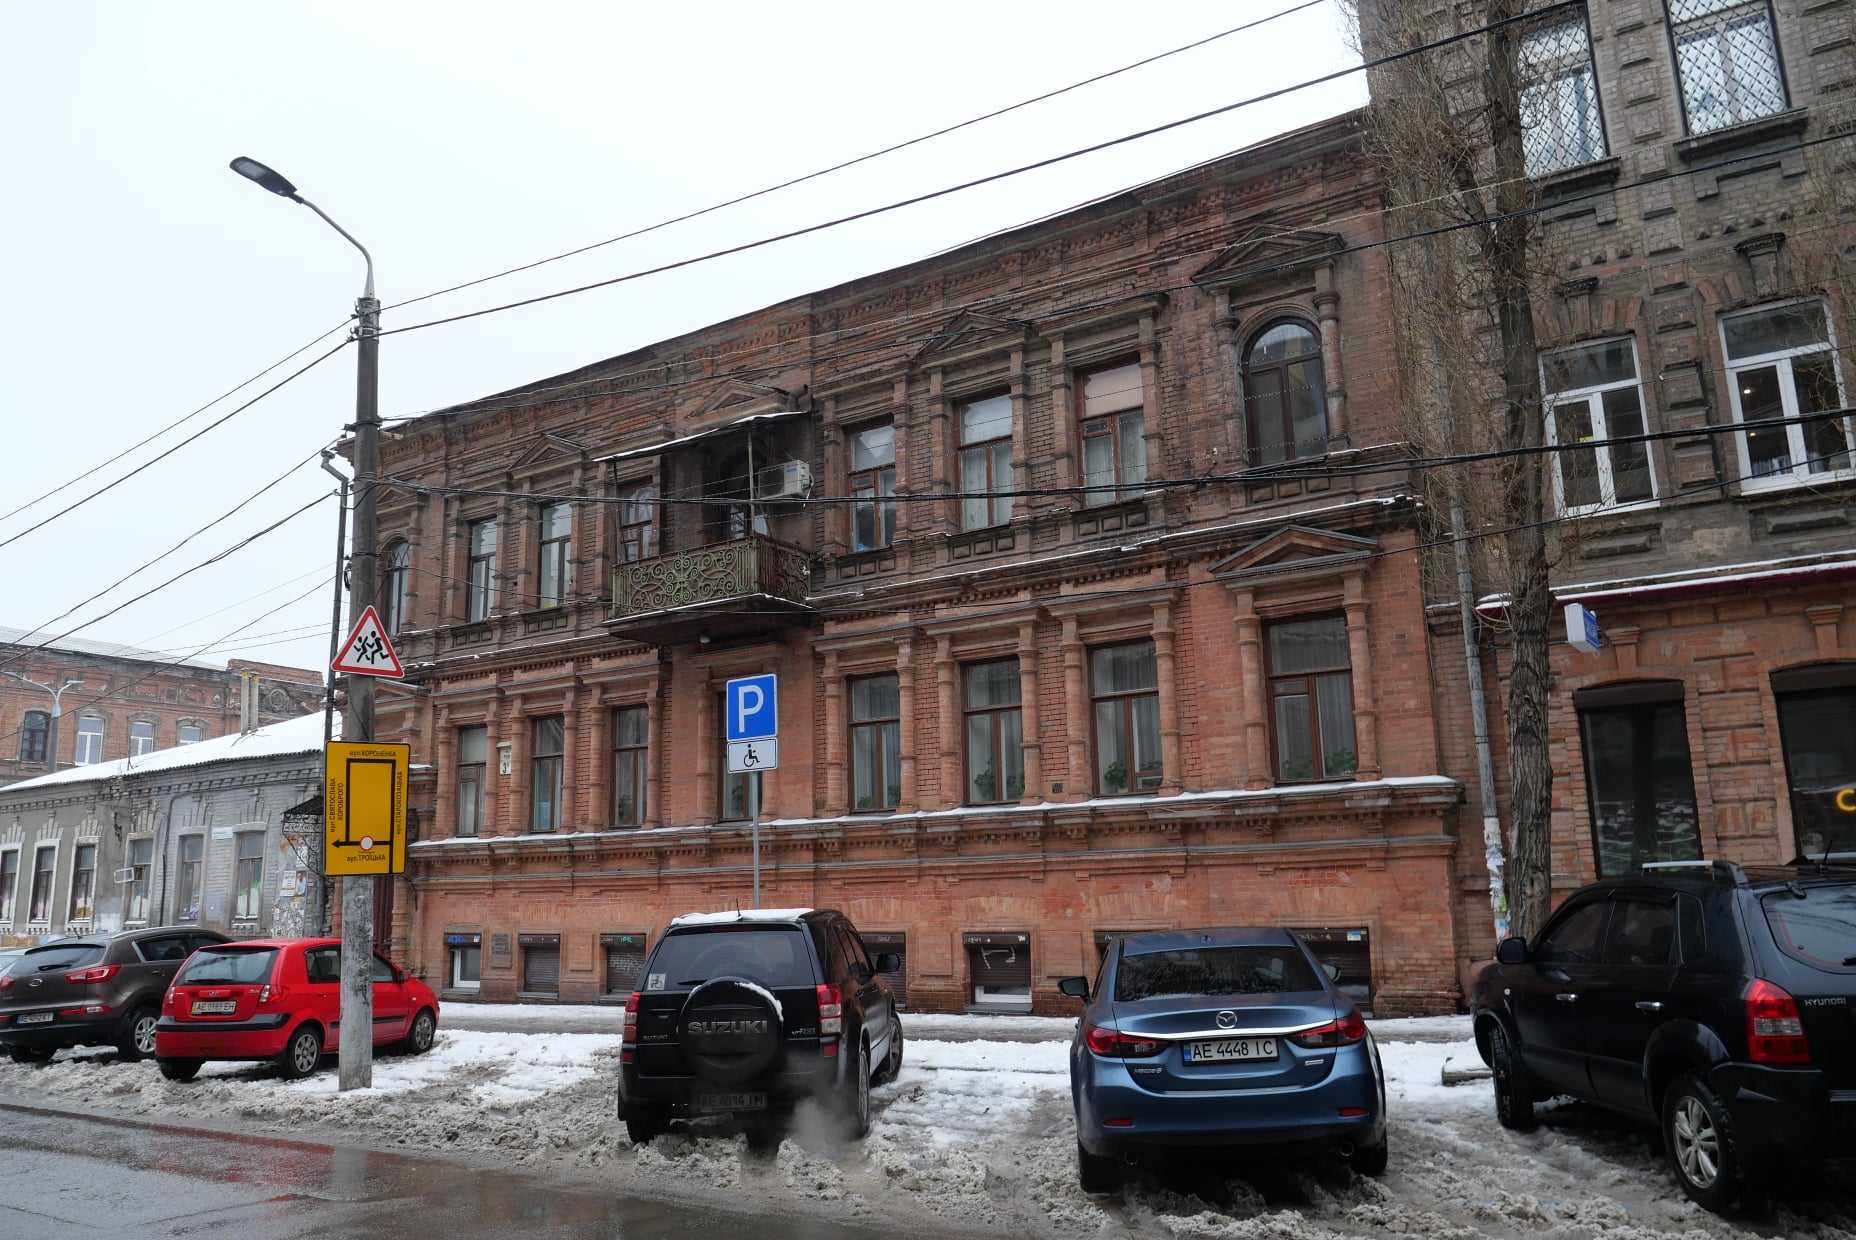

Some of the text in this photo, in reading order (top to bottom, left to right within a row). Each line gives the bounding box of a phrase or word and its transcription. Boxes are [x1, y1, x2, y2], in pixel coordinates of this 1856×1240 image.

[738, 685, 764, 733] P
[224, 1002, 234, 1011] EH
[1804, 998, 1847, 1006] HYUNDAI
[688, 1021, 767, 1035] SUZUKI
[1193, 1043, 1213, 1059] AE
[1217, 1041, 1249, 1058] 4448
